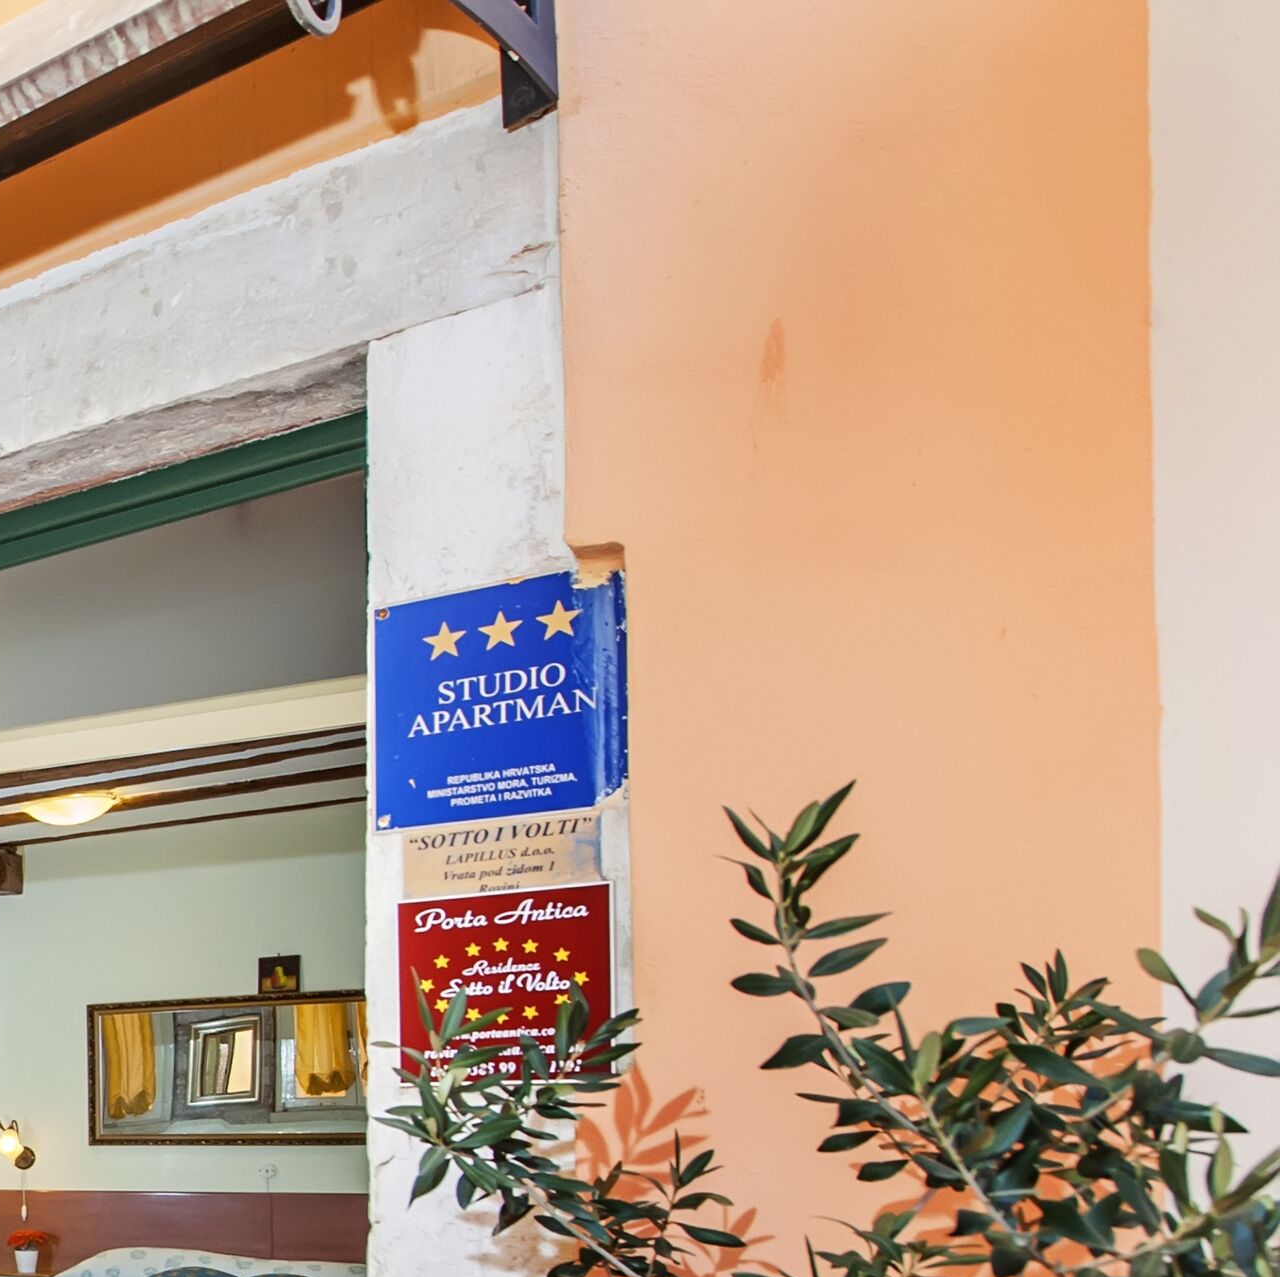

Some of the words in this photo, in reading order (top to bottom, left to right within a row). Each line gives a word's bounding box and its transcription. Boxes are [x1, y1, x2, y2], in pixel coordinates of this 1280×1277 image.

[438, 662, 566, 705] STUDIO
[407, 687, 597, 738] APARTMAN
[447, 770, 500, 785] REPUBLIKA
[502, 763, 556, 778] HRVATSKA
[427, 783, 496, 799] MINISTARSTVO
[450, 793, 496, 807] PROMETA
[498, 792, 503, 802] I
[503, 787, 552, 801] RAZVITKA
[495, 826, 505, 842] I
[445, 848, 517, 865] LAPILLUS
[443, 871, 476, 881] Vrata
[479, 866, 503, 881] pod
[506, 863, 543, 877] zidom
[414, 908, 488, 933] Porta
[493, 899, 589, 925] Antica
[462, 957, 541, 977] Residence
[498, 974, 515, 993] il
[516, 971, 571, 992] Volto
